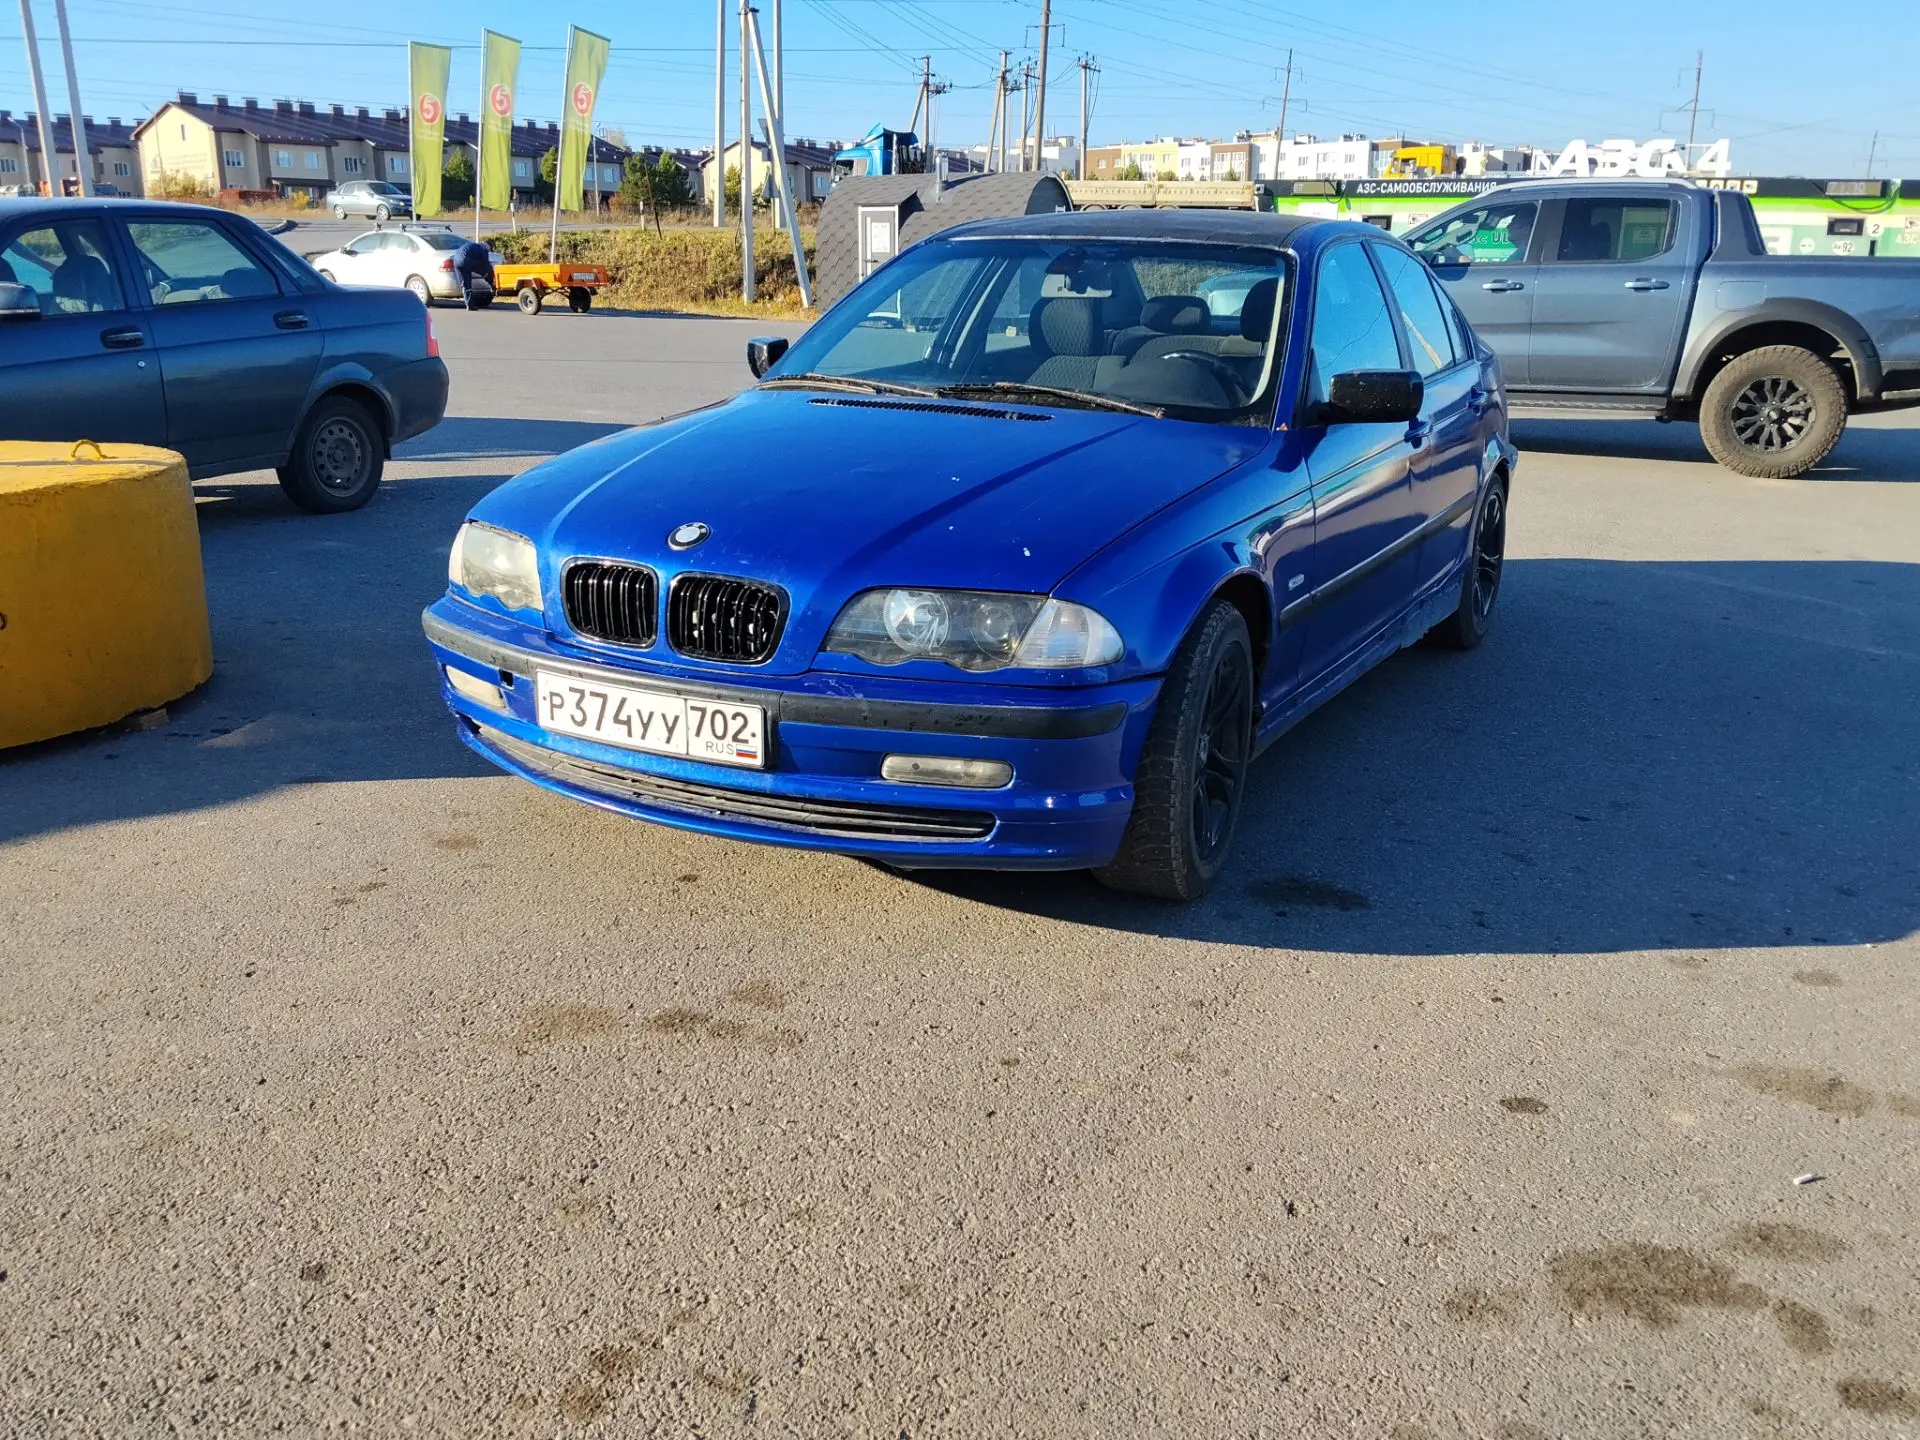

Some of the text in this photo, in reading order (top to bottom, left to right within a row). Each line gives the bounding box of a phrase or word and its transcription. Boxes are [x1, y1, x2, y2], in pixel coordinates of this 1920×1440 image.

[1697, 138, 1732, 177] 4
[1872, 223, 1880, 234] 2
[1842, 241, 1853, 253] 92
[689, 705, 750, 745] 702
[705, 741, 735, 755] RUS
